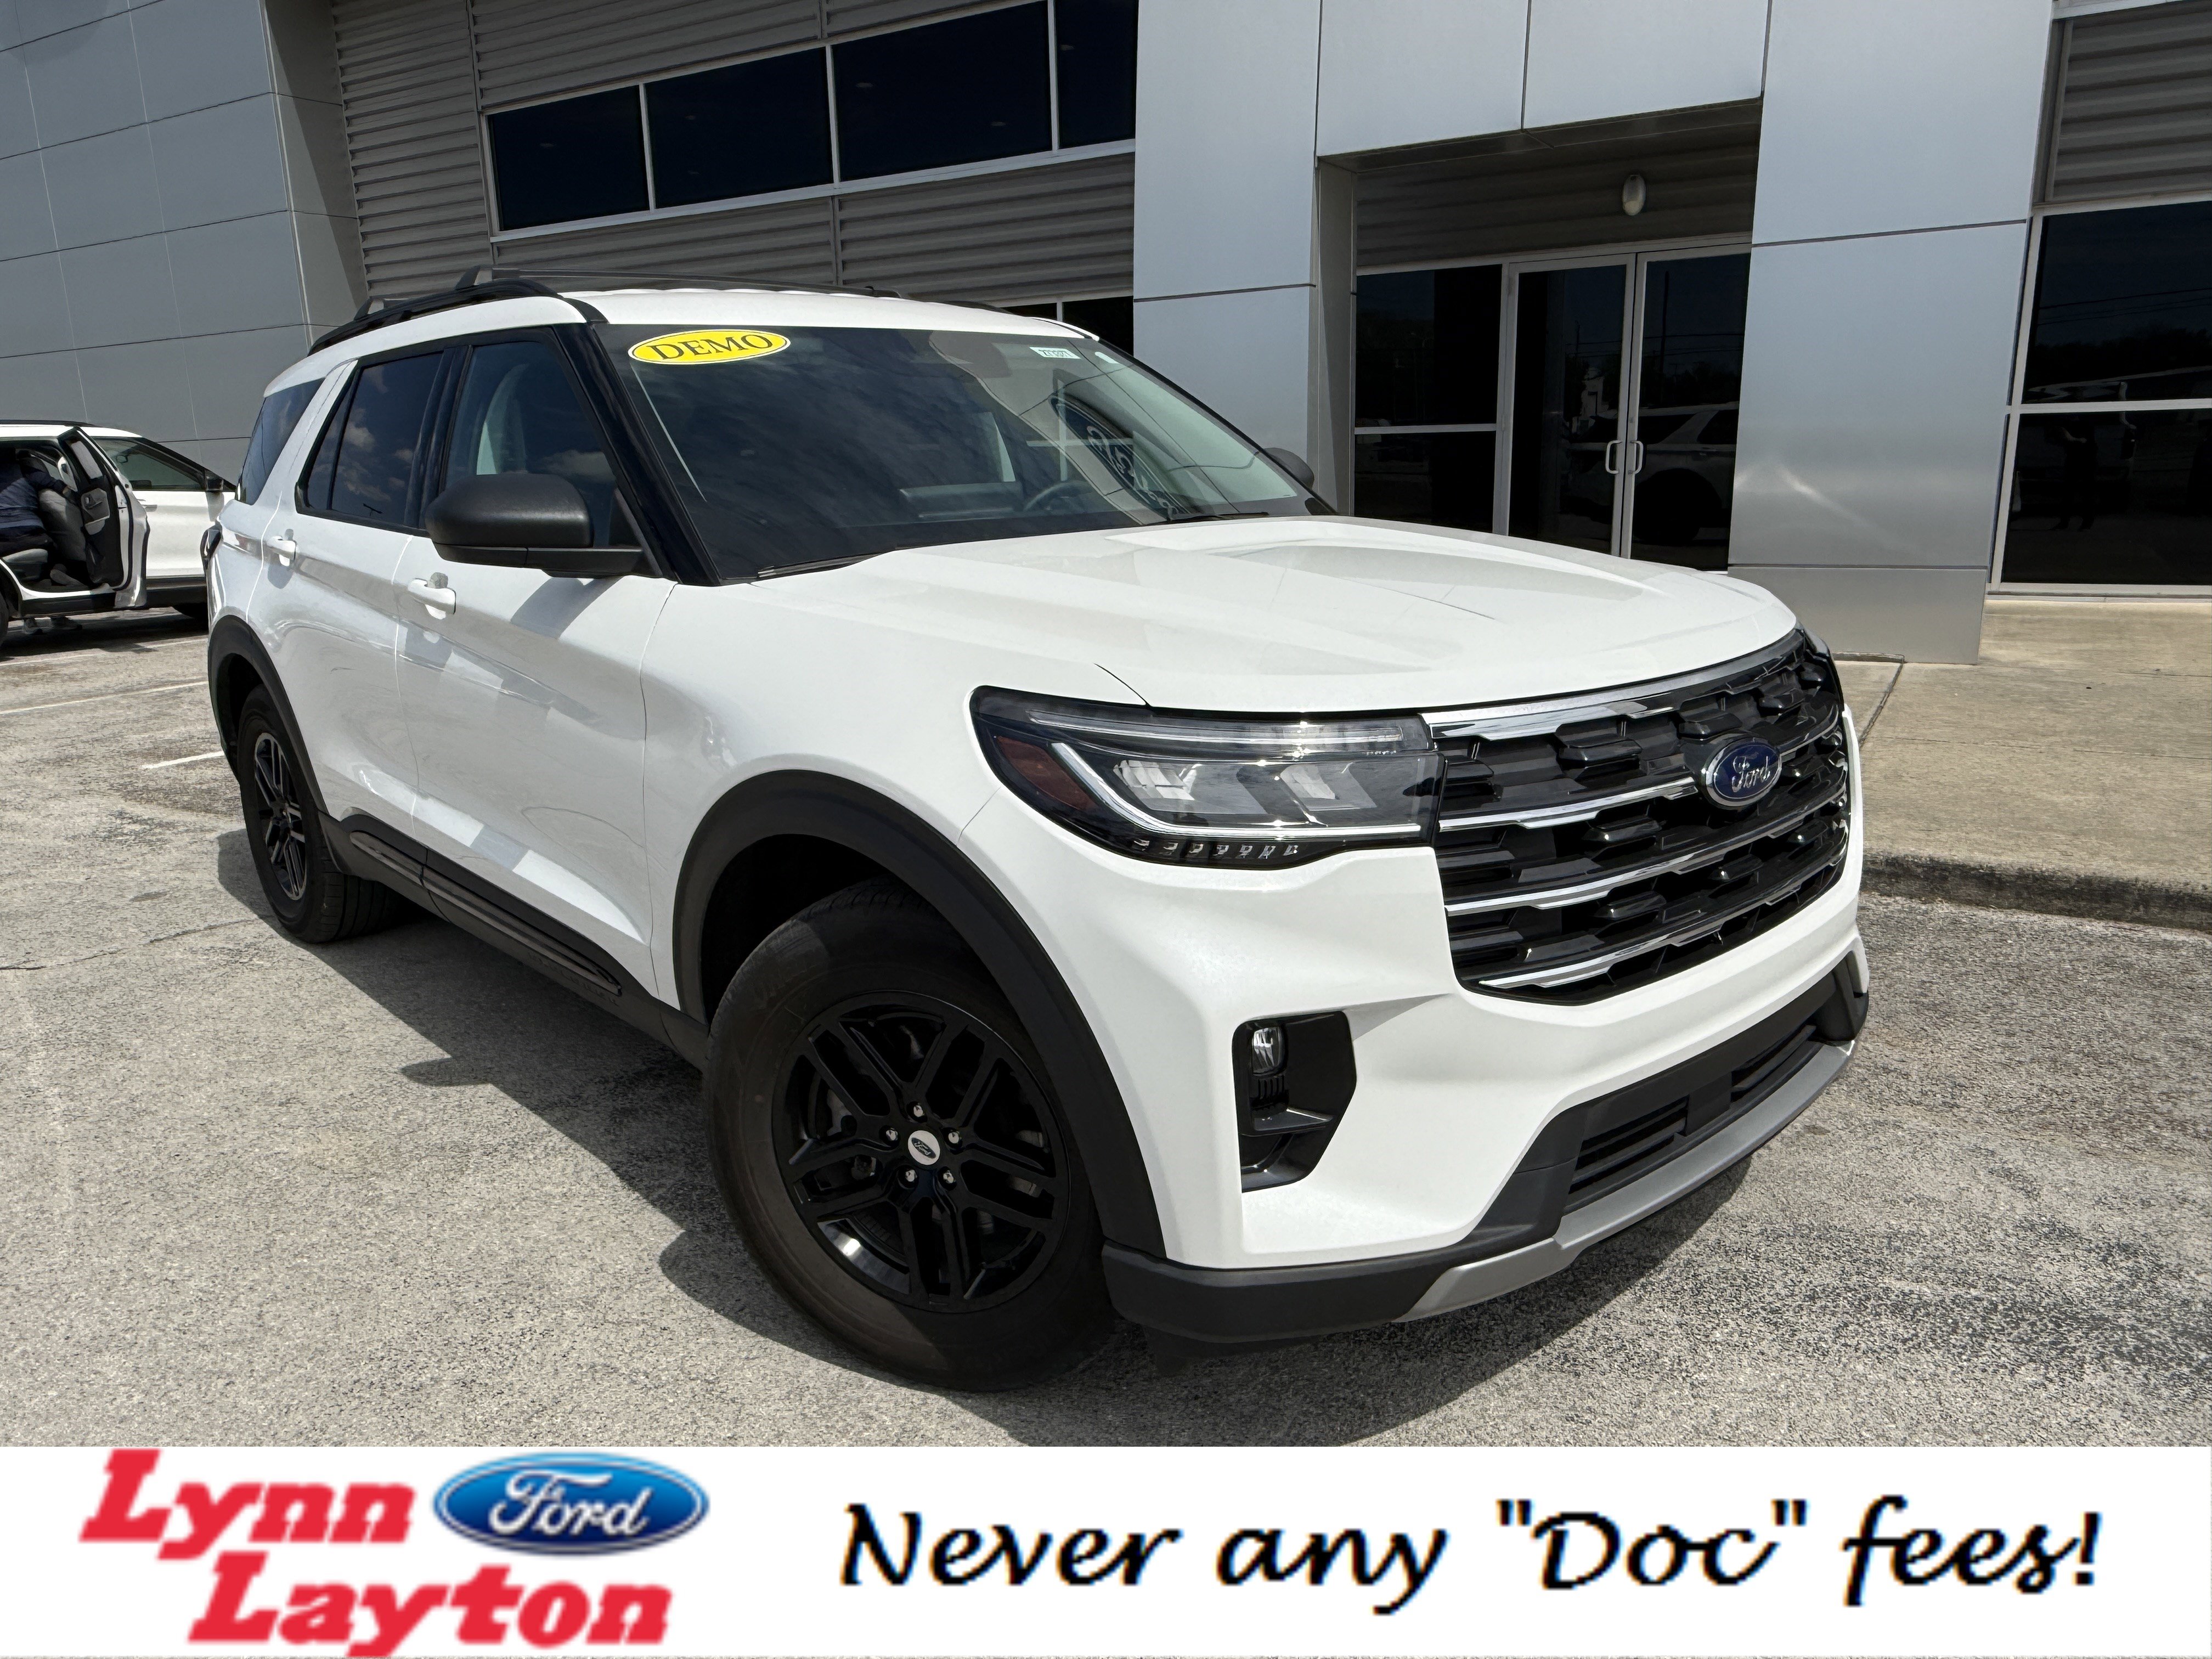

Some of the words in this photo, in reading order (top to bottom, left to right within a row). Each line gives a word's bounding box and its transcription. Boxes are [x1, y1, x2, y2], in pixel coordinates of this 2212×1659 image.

[647, 334, 773, 359] DEMO
[1731, 752, 1771, 793] Ford
[913, 1139, 932, 1156] Ford
